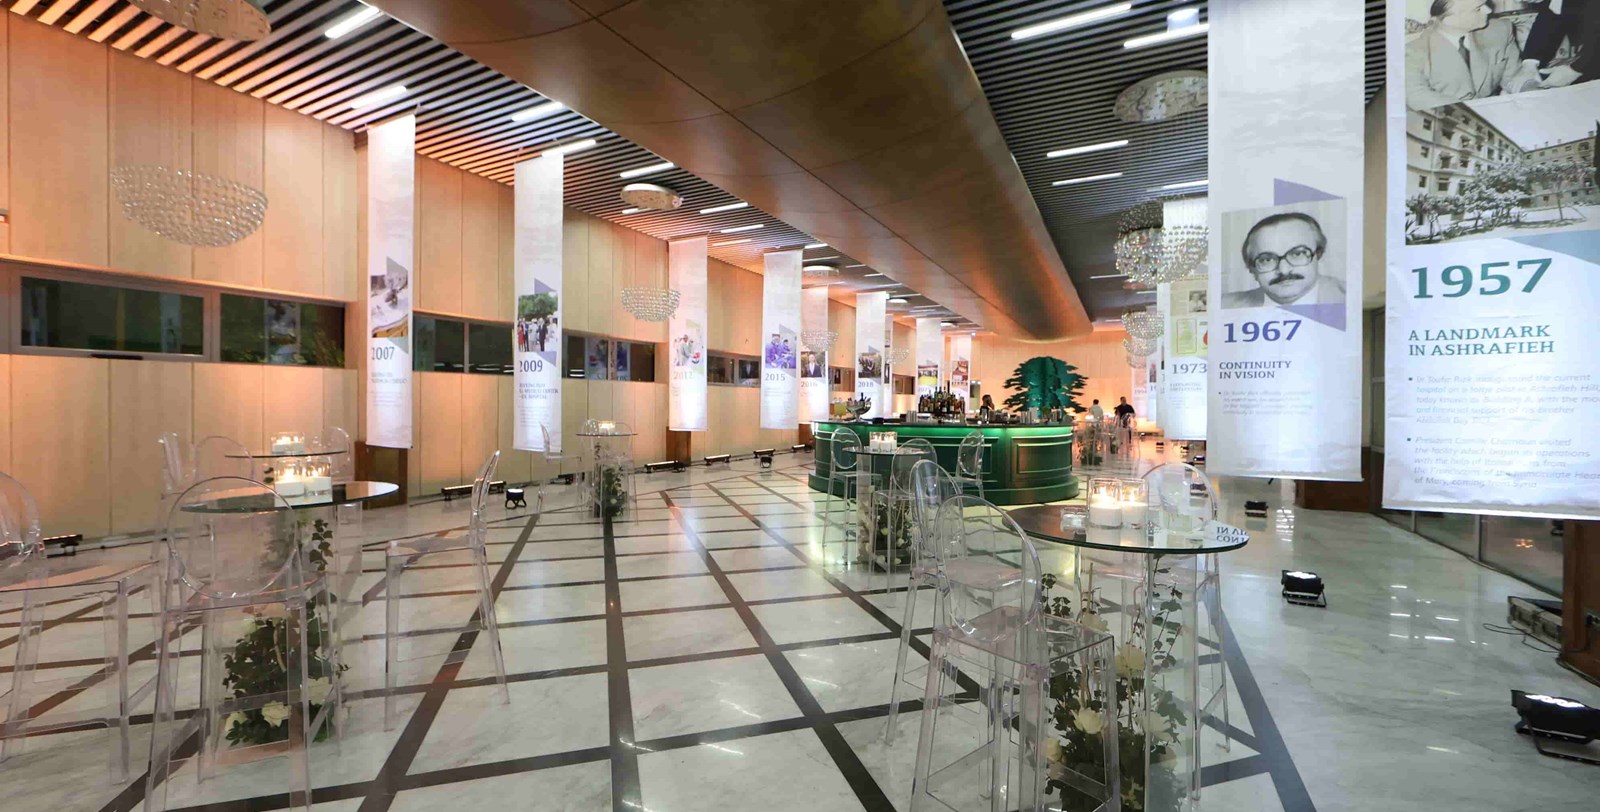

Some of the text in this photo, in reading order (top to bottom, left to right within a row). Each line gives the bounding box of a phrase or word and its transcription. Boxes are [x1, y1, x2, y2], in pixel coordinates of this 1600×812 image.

[1411, 257, 1553, 299] 1957
[1223, 319, 1303, 343] 1967
[1408, 325, 1551, 342] A LANDMARK
[1408, 340, 1555, 356] IN ASHRAFIEH
[519, 359, 544, 373] 2009
[1172, 363, 1208, 375] 1973
[1219, 360, 1292, 370] CONTINUITY
[765, 373, 786, 382] 2015
[1219, 370, 1276, 379] IN VISION
[1536, 450, 1591, 458] operations
